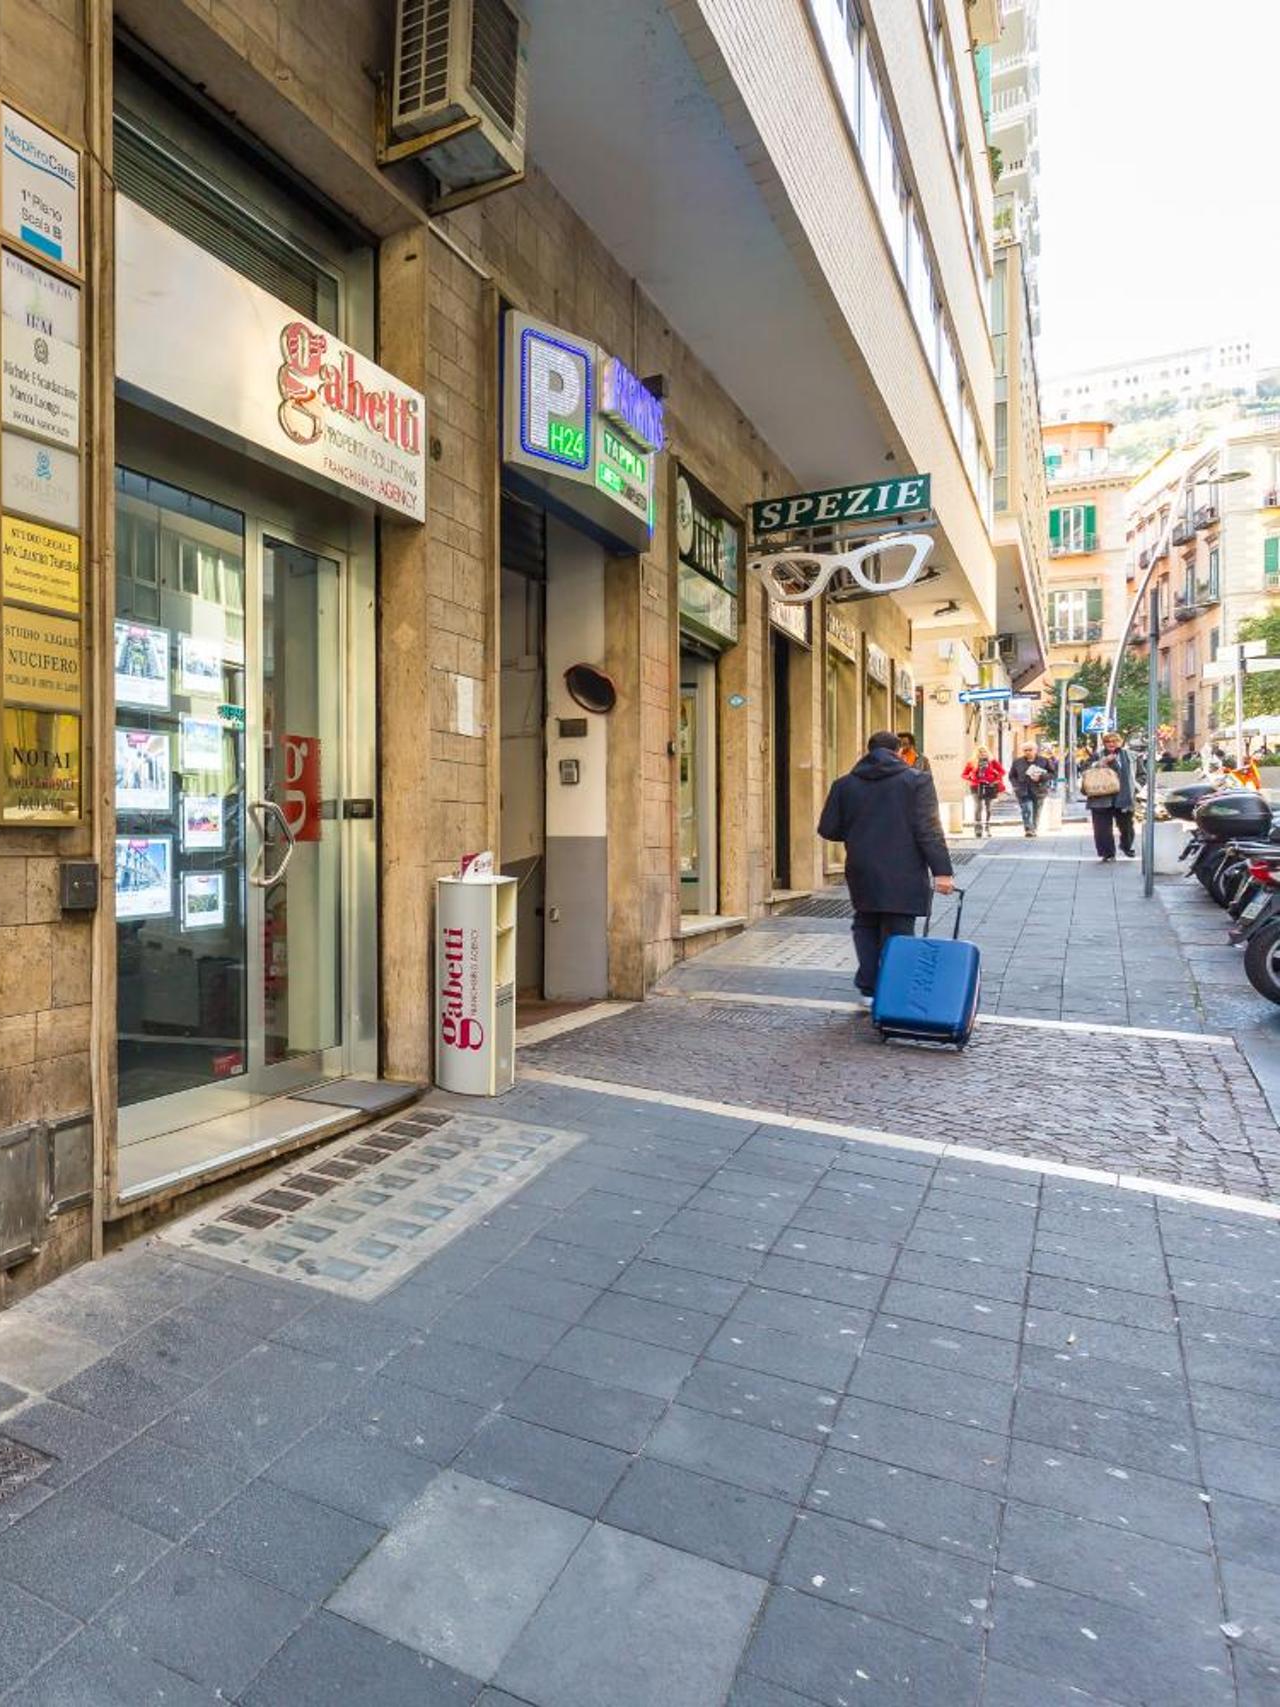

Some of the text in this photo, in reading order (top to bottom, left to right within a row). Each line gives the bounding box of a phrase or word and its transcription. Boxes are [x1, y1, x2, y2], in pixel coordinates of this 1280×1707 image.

[4, 125, 76, 182] NephroCare
[278, 321, 420, 456] gabetti
[529, 338, 581, 449] P
[551, 422, 584, 459] H24
[378, 479, 418, 511] AGENCY
[759, 479, 924, 529] SPEZIE
[5, 624, 40, 641] STUDIO
[8, 648, 78, 674] NUCIFERO
[12, 747, 70, 769] NOTAI
[441, 927, 484, 1051] gabetti
